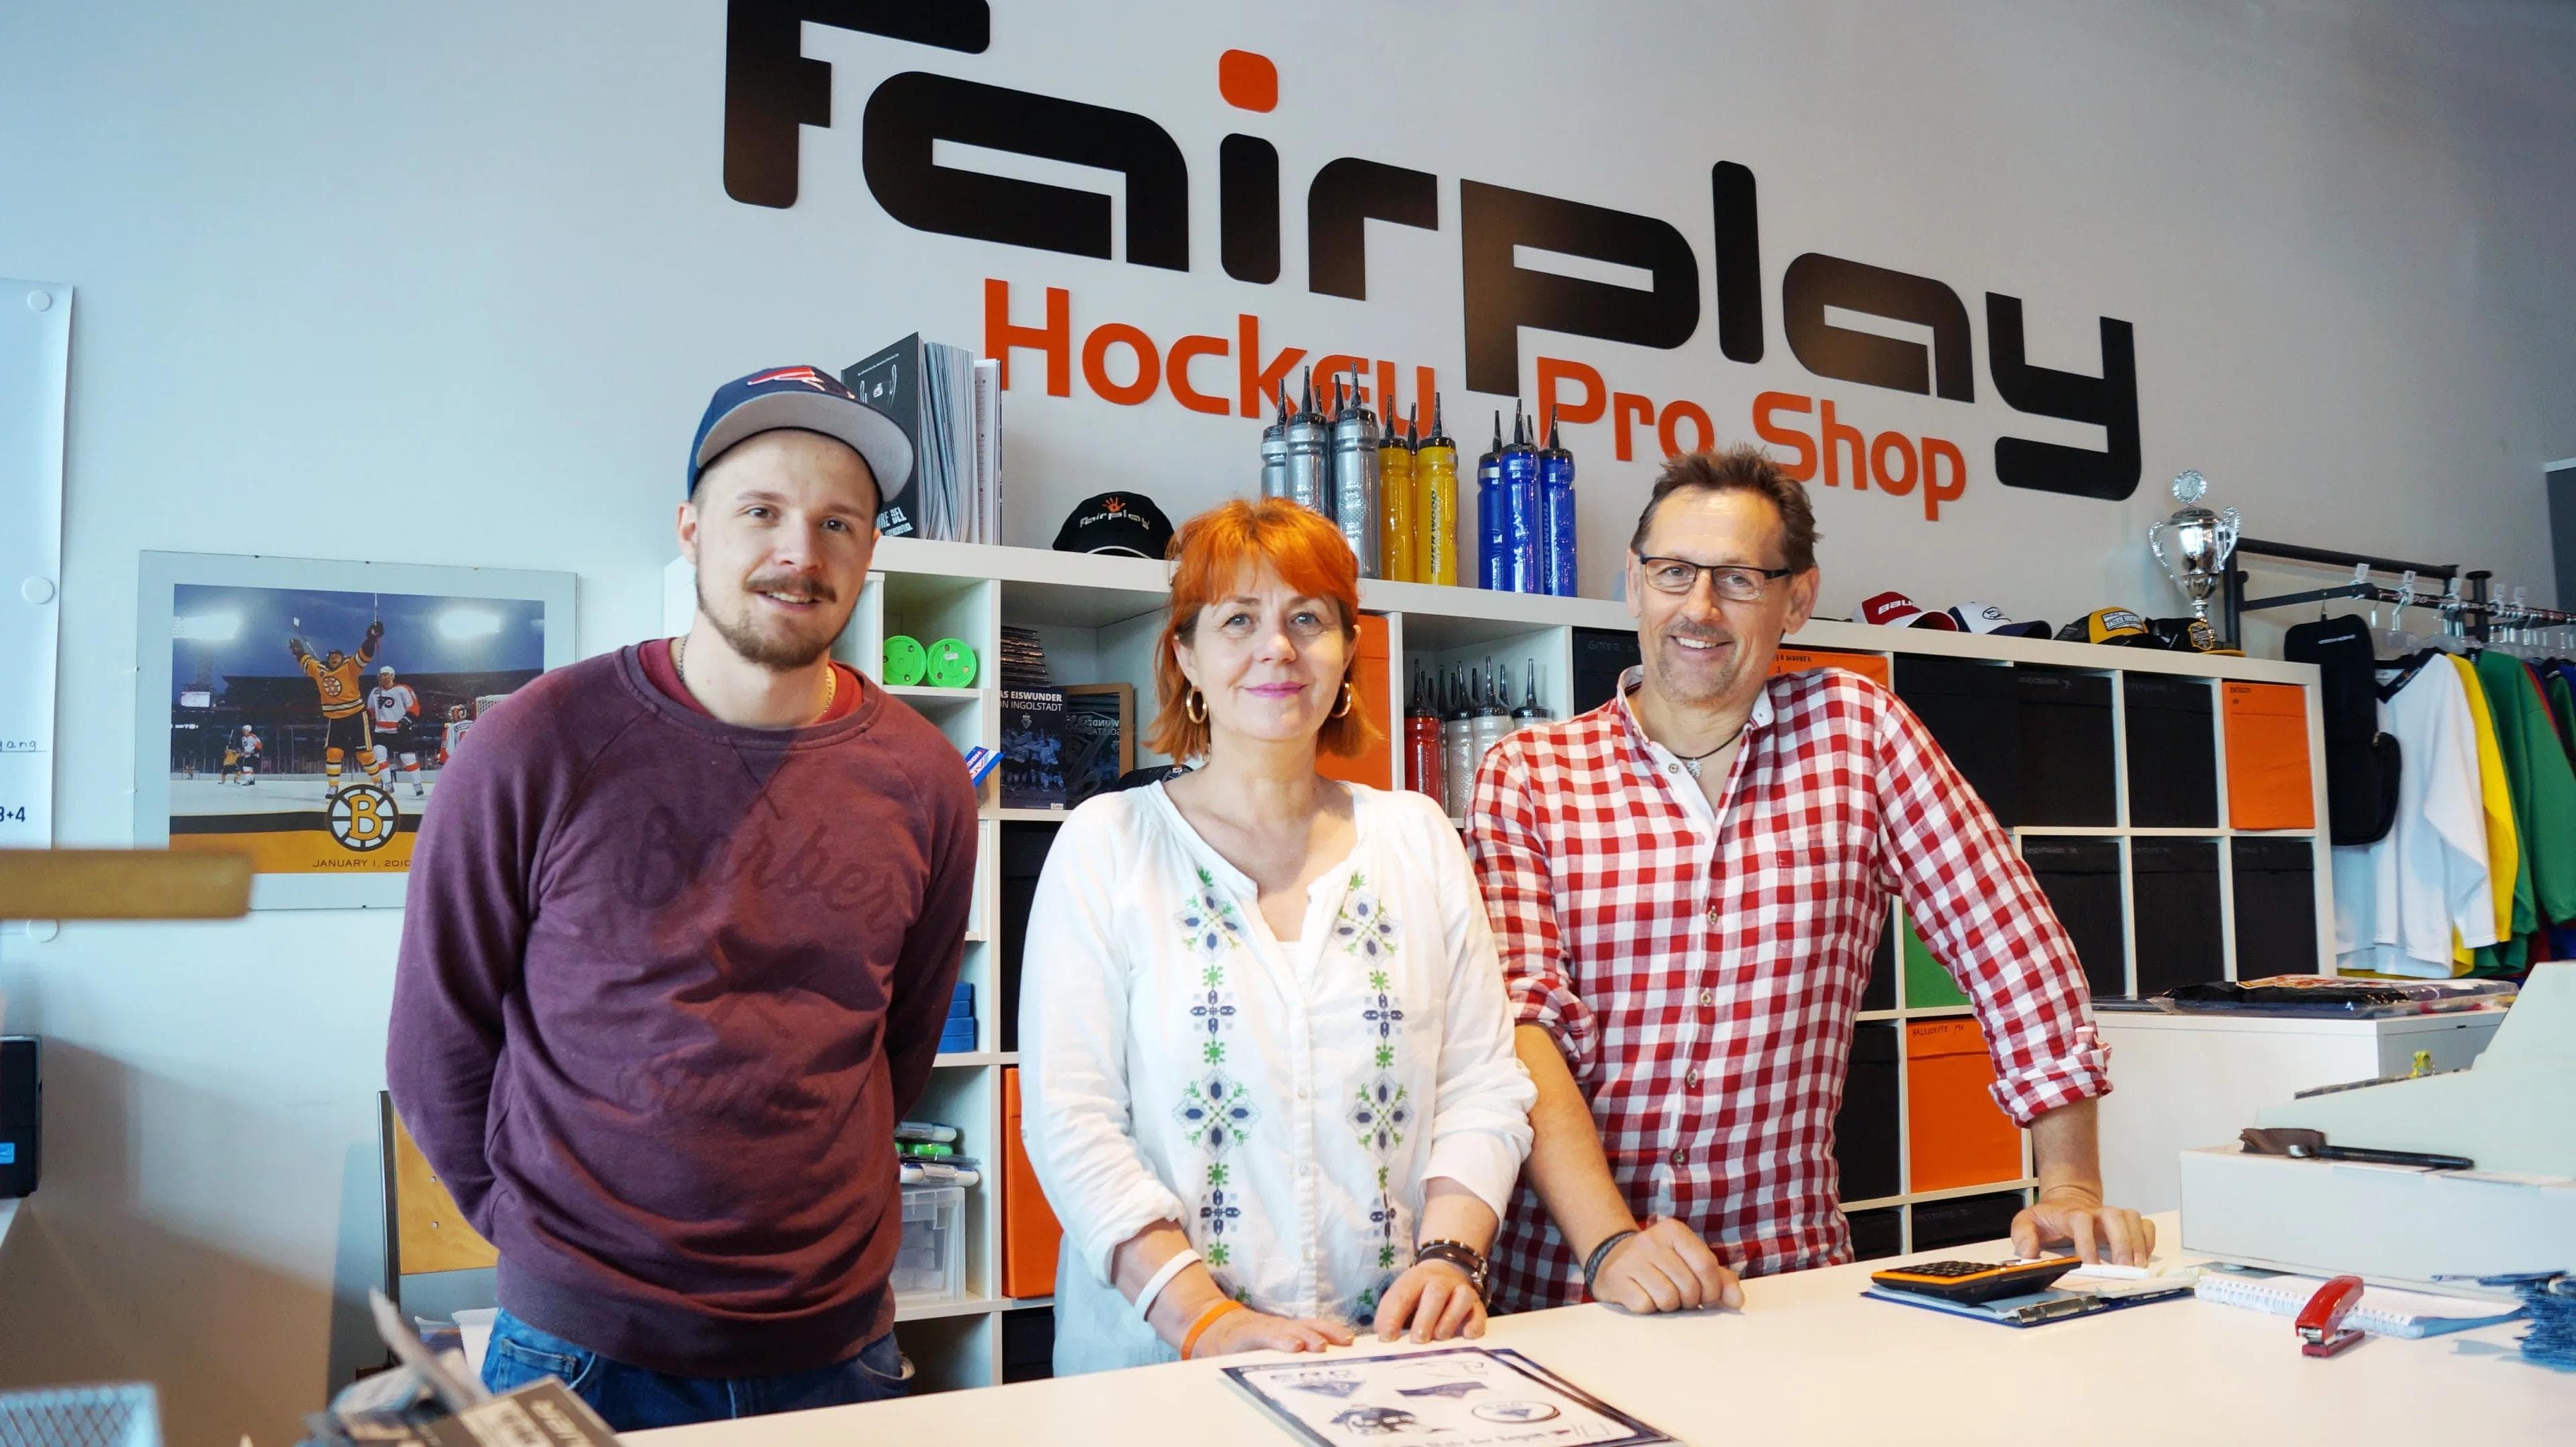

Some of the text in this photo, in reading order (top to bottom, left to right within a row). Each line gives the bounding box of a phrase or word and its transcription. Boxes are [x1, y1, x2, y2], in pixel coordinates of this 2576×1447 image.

[1537, 356, 1715, 463] Pro
[1752, 390, 1967, 522] Shop
[1079, 509, 1150, 531] fairplay
[1878, 599, 1913, 615] BAU
[1000, 690, 1063, 702] AS EISWUNDER
[1010, 700, 1063, 712] INGOLSTADT
[349, 794, 383, 841] B
[313, 859, 368, 867] JANUARY
